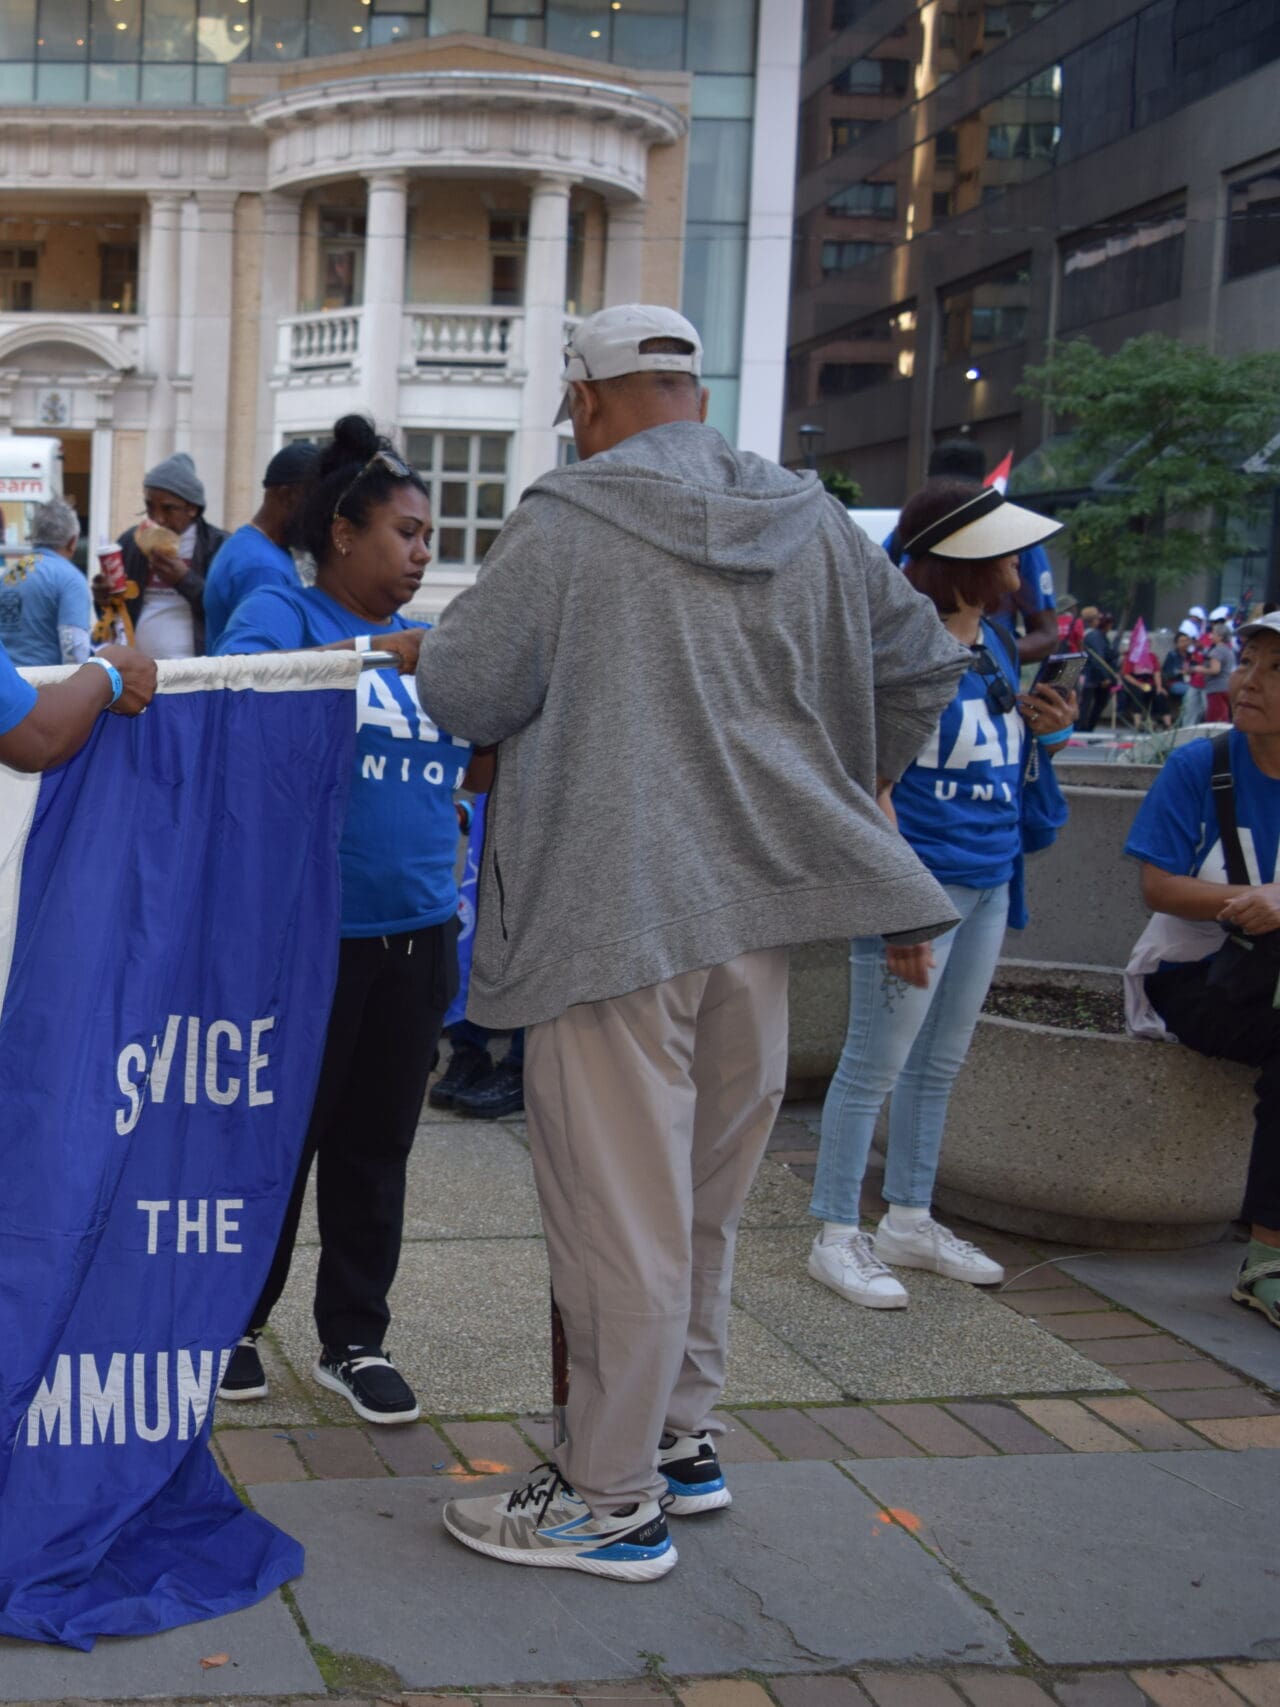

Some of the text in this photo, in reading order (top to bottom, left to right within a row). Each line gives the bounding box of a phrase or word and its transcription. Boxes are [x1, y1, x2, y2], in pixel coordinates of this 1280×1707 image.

[934, 780, 1012, 802] UNI
[115, 1014, 276, 1137] SVICE
[137, 1198, 244, 1255] THE
[27, 1349, 232, 1447] MMUN
